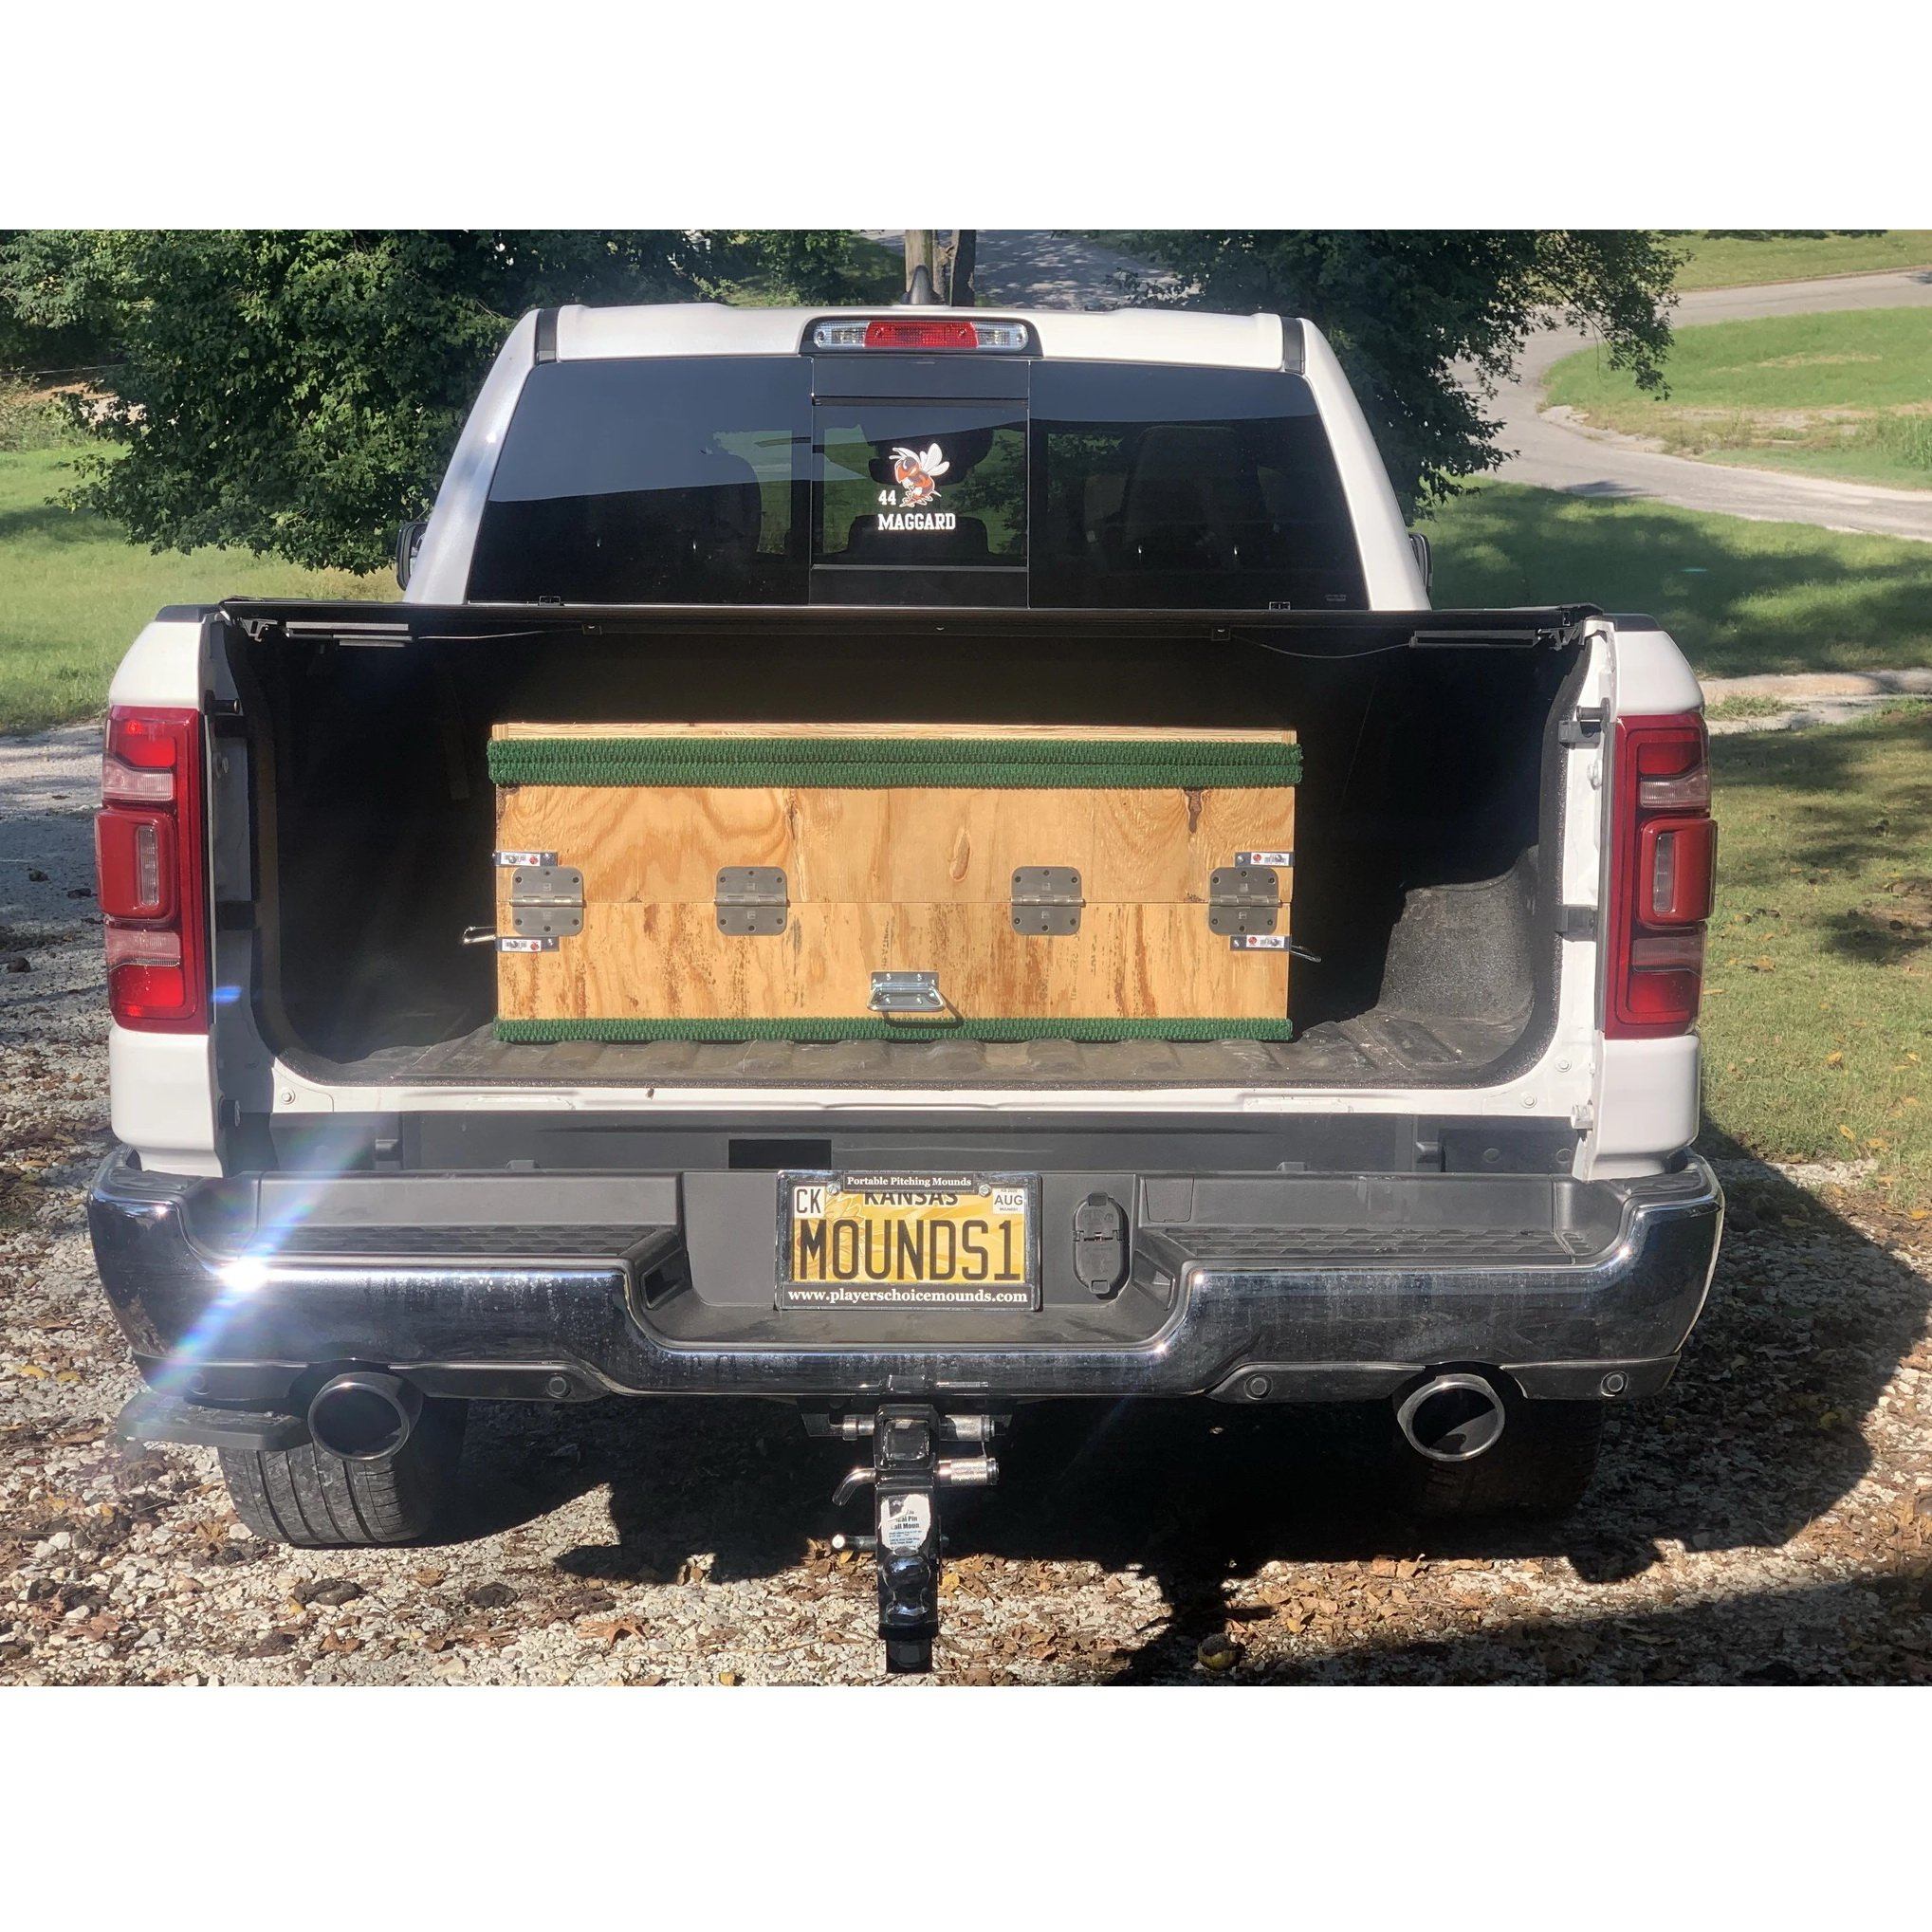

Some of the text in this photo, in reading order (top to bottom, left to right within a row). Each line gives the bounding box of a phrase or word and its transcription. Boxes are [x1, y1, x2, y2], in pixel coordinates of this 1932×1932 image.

[878, 489, 896, 506] 44
[877, 513, 956, 530] MAGGARD
[847, 1176, 972, 1187] Portable Pitching Mounds
[796, 1188, 821, 1214] CK
[994, 1194, 1023, 1205] AUG
[800, 1220, 1021, 1280] MOUNDS1
[788, 1288, 1028, 1304] www.playerschoicemounds.com
